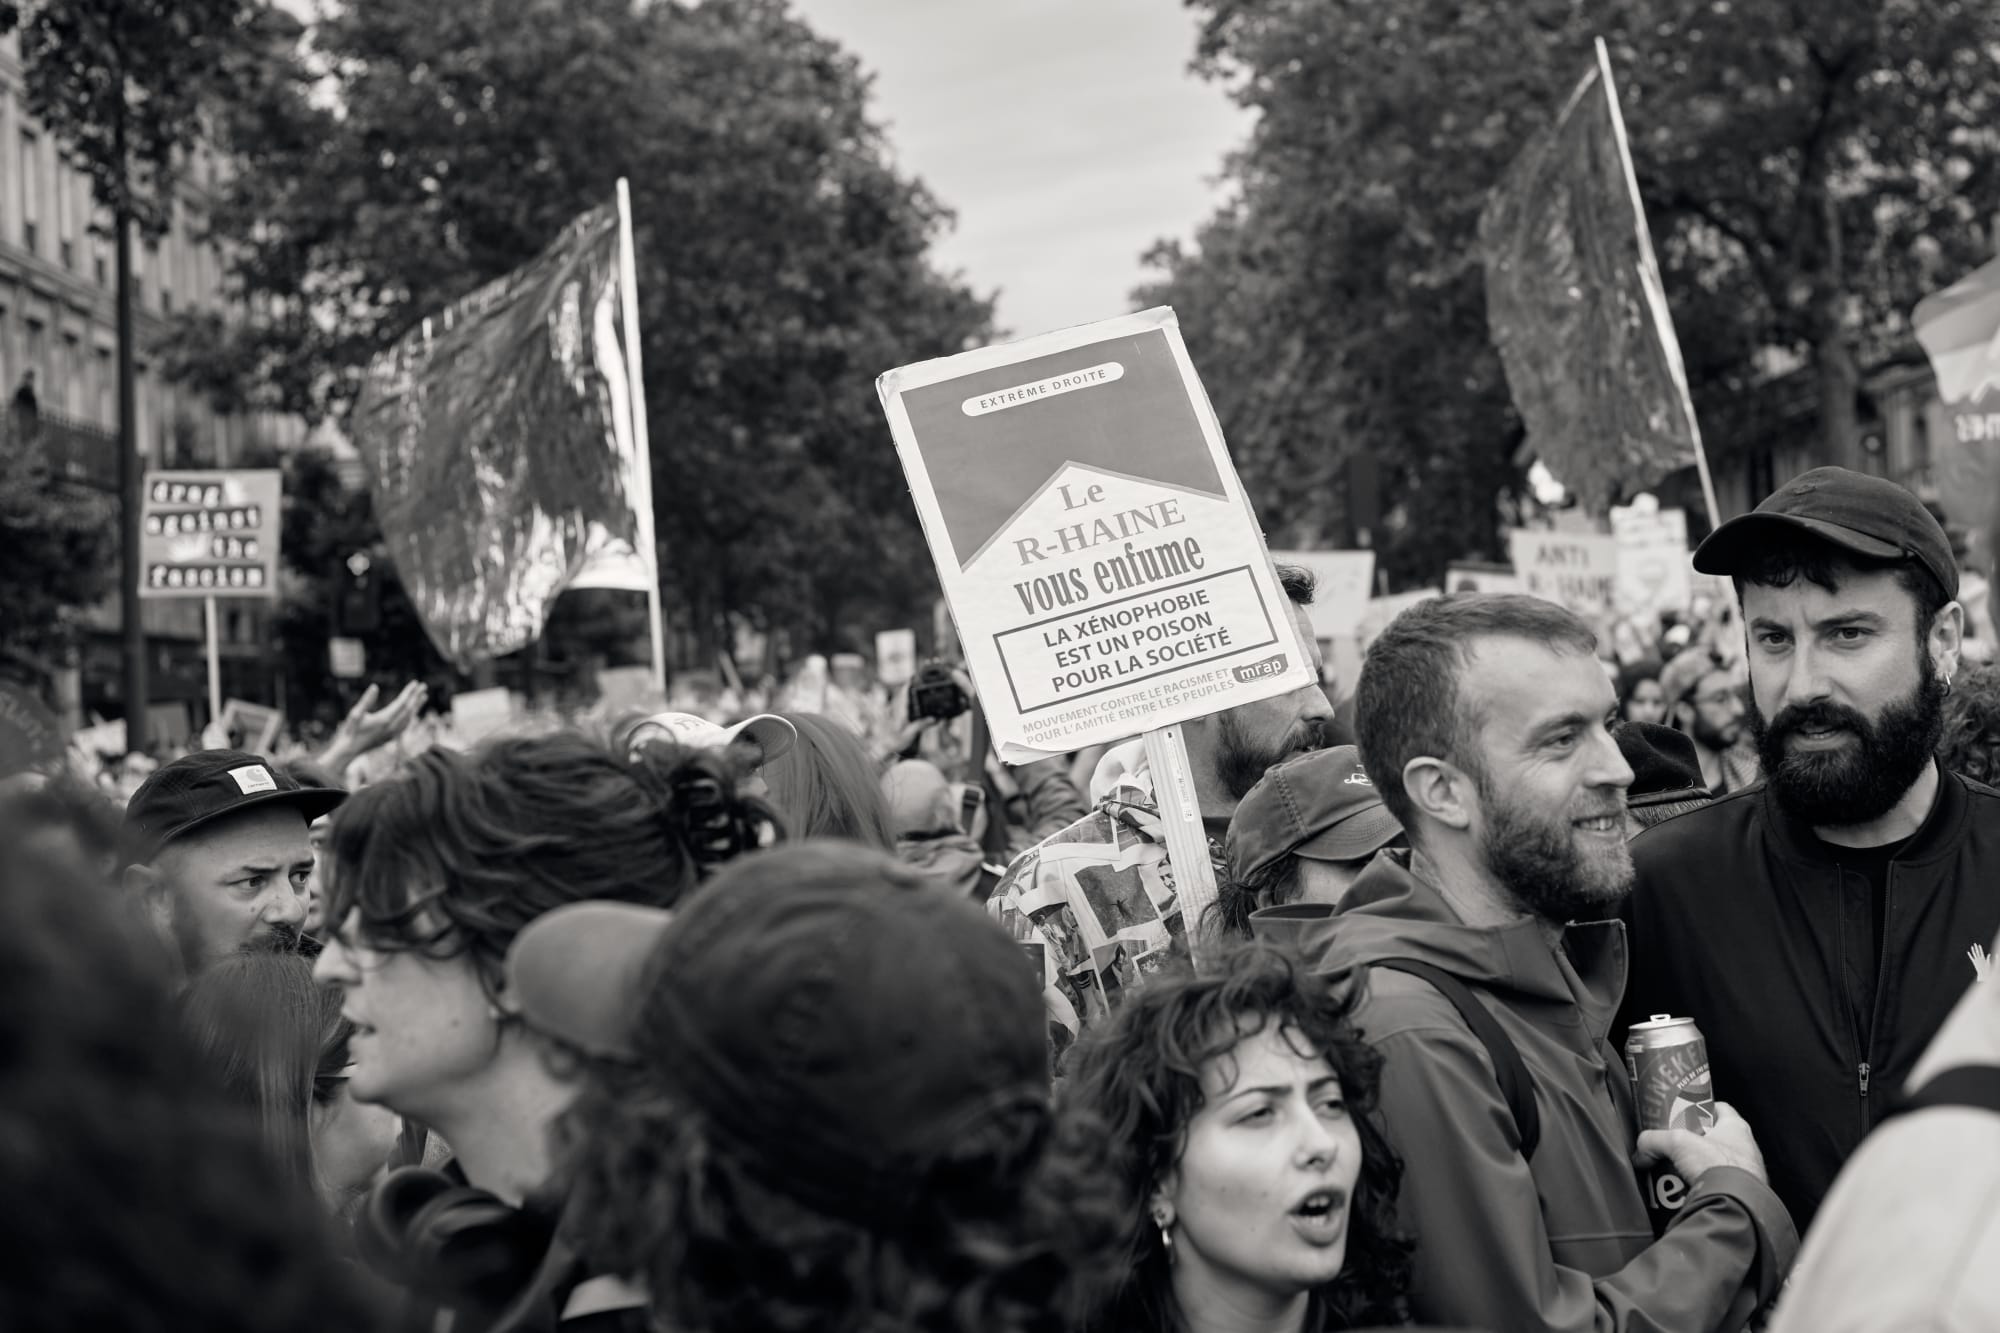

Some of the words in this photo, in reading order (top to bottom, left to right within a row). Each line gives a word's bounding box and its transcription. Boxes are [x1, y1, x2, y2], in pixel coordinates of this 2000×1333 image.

[980, 385, 1047, 409] EXTRÊME
[1052, 369, 1106, 390] DROITE
[153, 480, 219, 508] drag
[1057, 483, 1105, 511] Le
[146, 507, 259, 537] against
[1013, 498, 1186, 566] R-HAINE
[213, 537, 258, 560] the
[152, 565, 262, 588] fascism
[1013, 567, 1089, 615] vous
[1093, 536, 1205, 594] enfume
[1043, 628, 1072, 648] LA
[1073, 589, 1210, 639] XÉNOPHOBIE
[1055, 644, 1091, 669] EST
[1097, 633, 1130, 656] UN
[1132, 611, 1213, 646] POISON
[1052, 663, 1113, 693] POUR
[1115, 655, 1144, 676] LA
[1146, 627, 1232, 667] SOCIÉTÉ
[1240, 659, 1282, 680] mrap
[1023, 704, 1098, 734] MOUVEMENT
[1100, 691, 1149, 712] CONTRE
[1149, 687, 1161, 698] LE
[1163, 672, 1214, 694] RACISME
[1216, 668, 1229, 680] ET
[1026, 728, 1061, 745] POUR
[1063, 711, 1117, 736] L'AMITIÉ
[1119, 701, 1157, 720] ENTRE
[1159, 695, 1180, 709] LES
[1183, 680, 1235, 702] PEUPLES
